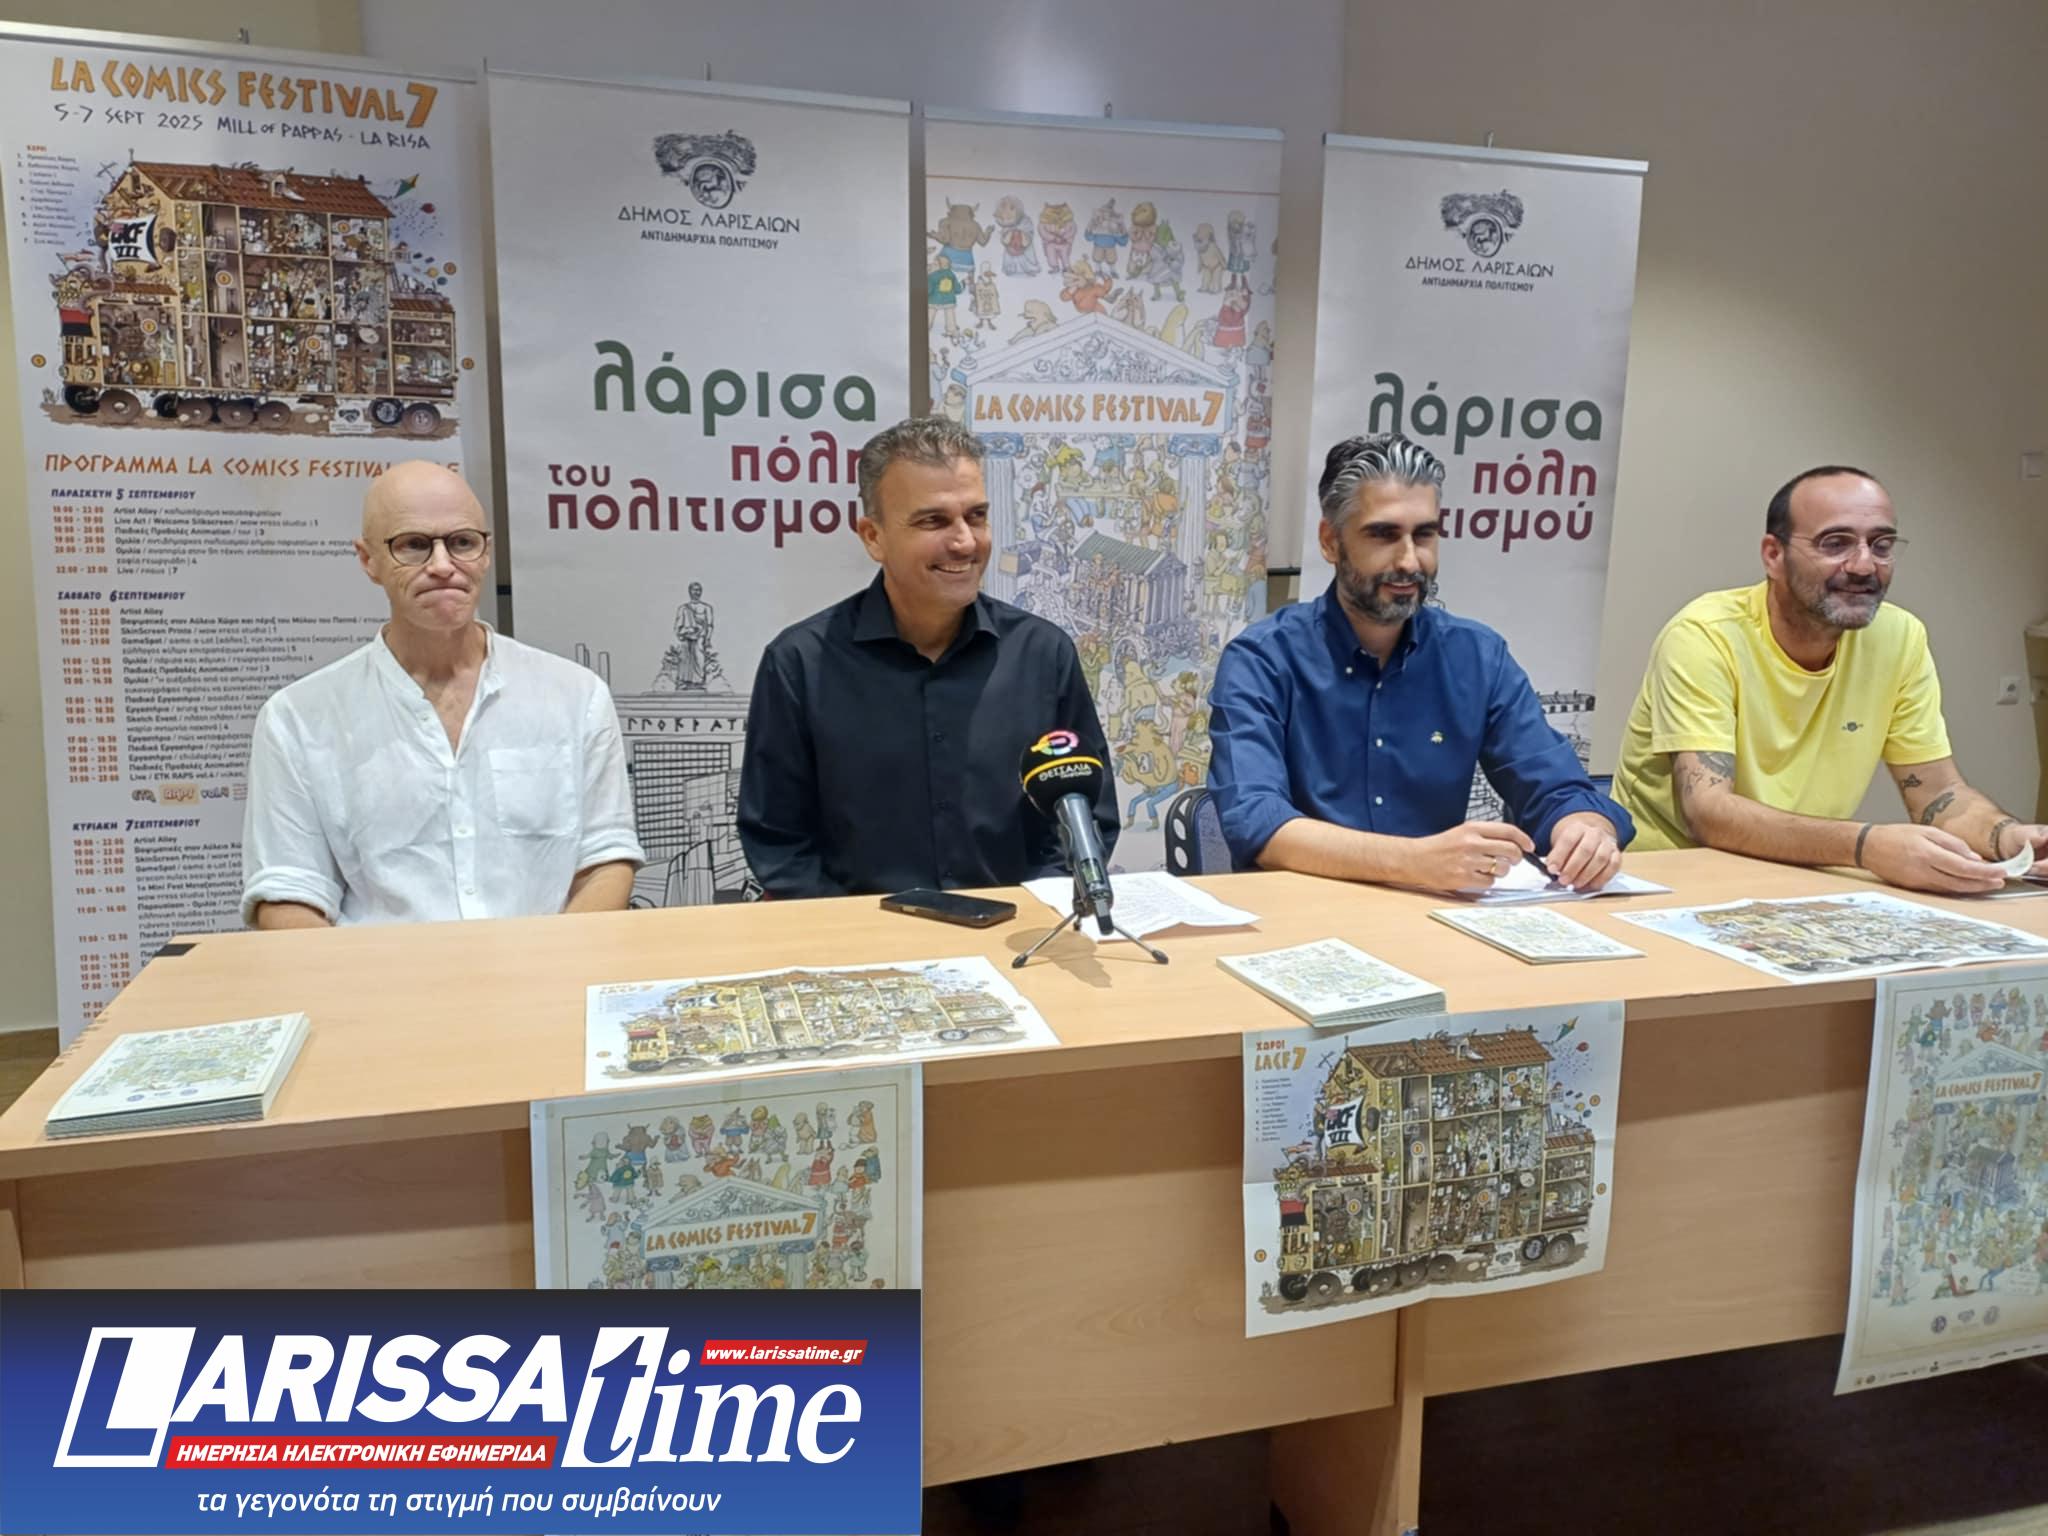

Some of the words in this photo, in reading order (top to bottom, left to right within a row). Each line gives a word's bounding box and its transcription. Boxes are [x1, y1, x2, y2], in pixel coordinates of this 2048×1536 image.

[51, 57, 95, 93] LA
[101, 60, 226, 106] COMICS
[105, 107, 145, 125] SEPT
[158, 113, 203, 131] 2025
[217, 116, 257, 135] MILL
[281, 122, 343, 143] PAPPAS
[617, 205, 693, 226] ΔΗΜΟΣ
[700, 213, 800, 233] ΛΑΡΙΣΑΙΩΝ
[640, 229, 716, 245] ΑΝΤΙΔΗΜΑΡΧΙΑ
[718, 235, 779, 249] ΠΟΛΙΤΙΣΜΟΥ
[1405, 256, 1465, 273] ΔΗΜΟΣ
[1471, 261, 1554, 277] ΛΑΡΙΣΑΙΩΝ
[593, 340, 876, 437] λάρισα
[974, 394, 1003, 422] LA
[1007, 393, 1086, 423] COMICS
[1368, 372, 1603, 456] λάρισα
[45, 454, 178, 474] ΠΡΟΓΡΑΜΜΑ
[188, 456, 213, 474] LA
[223, 458, 300, 476] COMICS
[548, 463, 611, 487] του
[1473, 448, 1597, 496] πόλη
[647, 1233, 665, 1251] LA
[668, 1226, 722, 1249] COMICS
